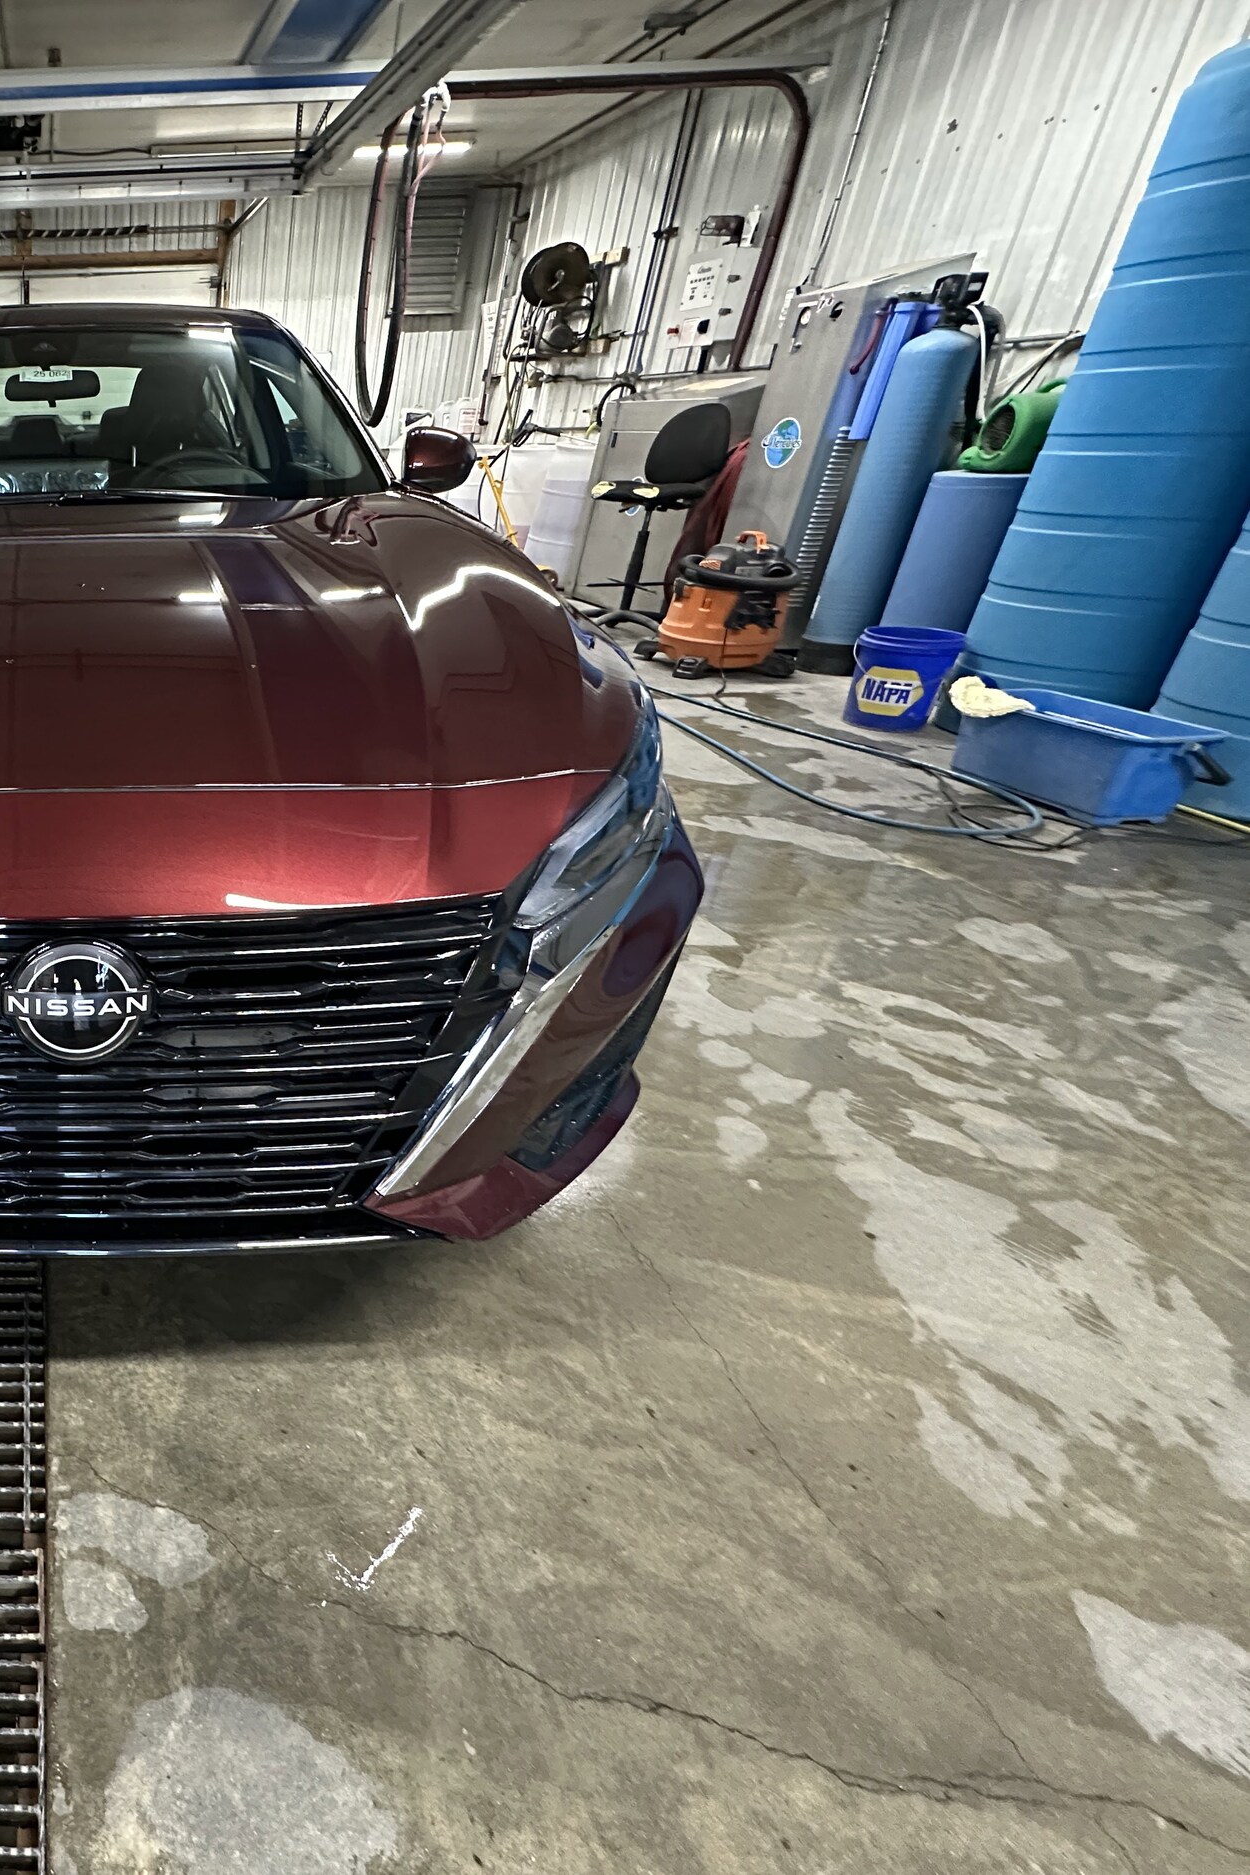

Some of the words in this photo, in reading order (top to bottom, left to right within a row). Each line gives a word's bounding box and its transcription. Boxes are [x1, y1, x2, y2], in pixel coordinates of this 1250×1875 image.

[33, 370, 46, 378] 25
[861, 678, 913, 704] NAPA
[7, 994, 148, 1017] NISSAN
